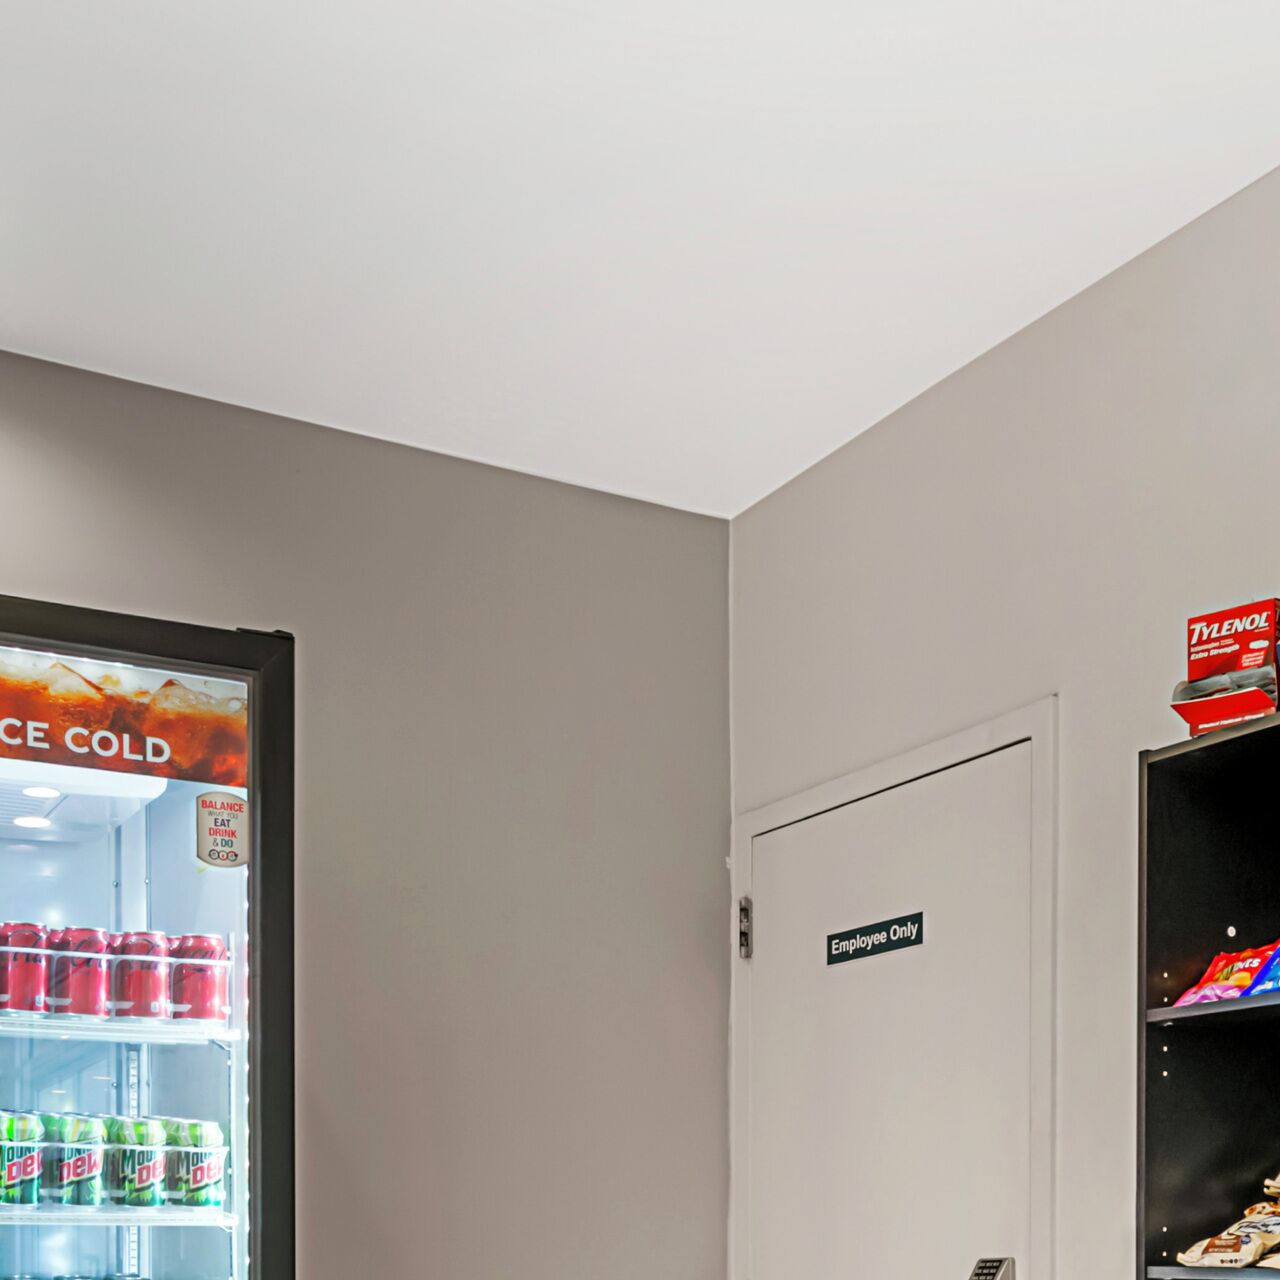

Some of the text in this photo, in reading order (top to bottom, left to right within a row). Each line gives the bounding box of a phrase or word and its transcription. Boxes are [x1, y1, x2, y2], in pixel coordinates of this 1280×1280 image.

[1190, 611, 1270, 645] TYLENOL
[65, 727, 172, 764] COLD
[201, 799, 244, 813] BALANCE
[214, 818, 231, 828] EAT
[208, 827, 237, 839] DRINK
[221, 838, 233, 848] DO
[831, 921, 918, 955] Employee Only
